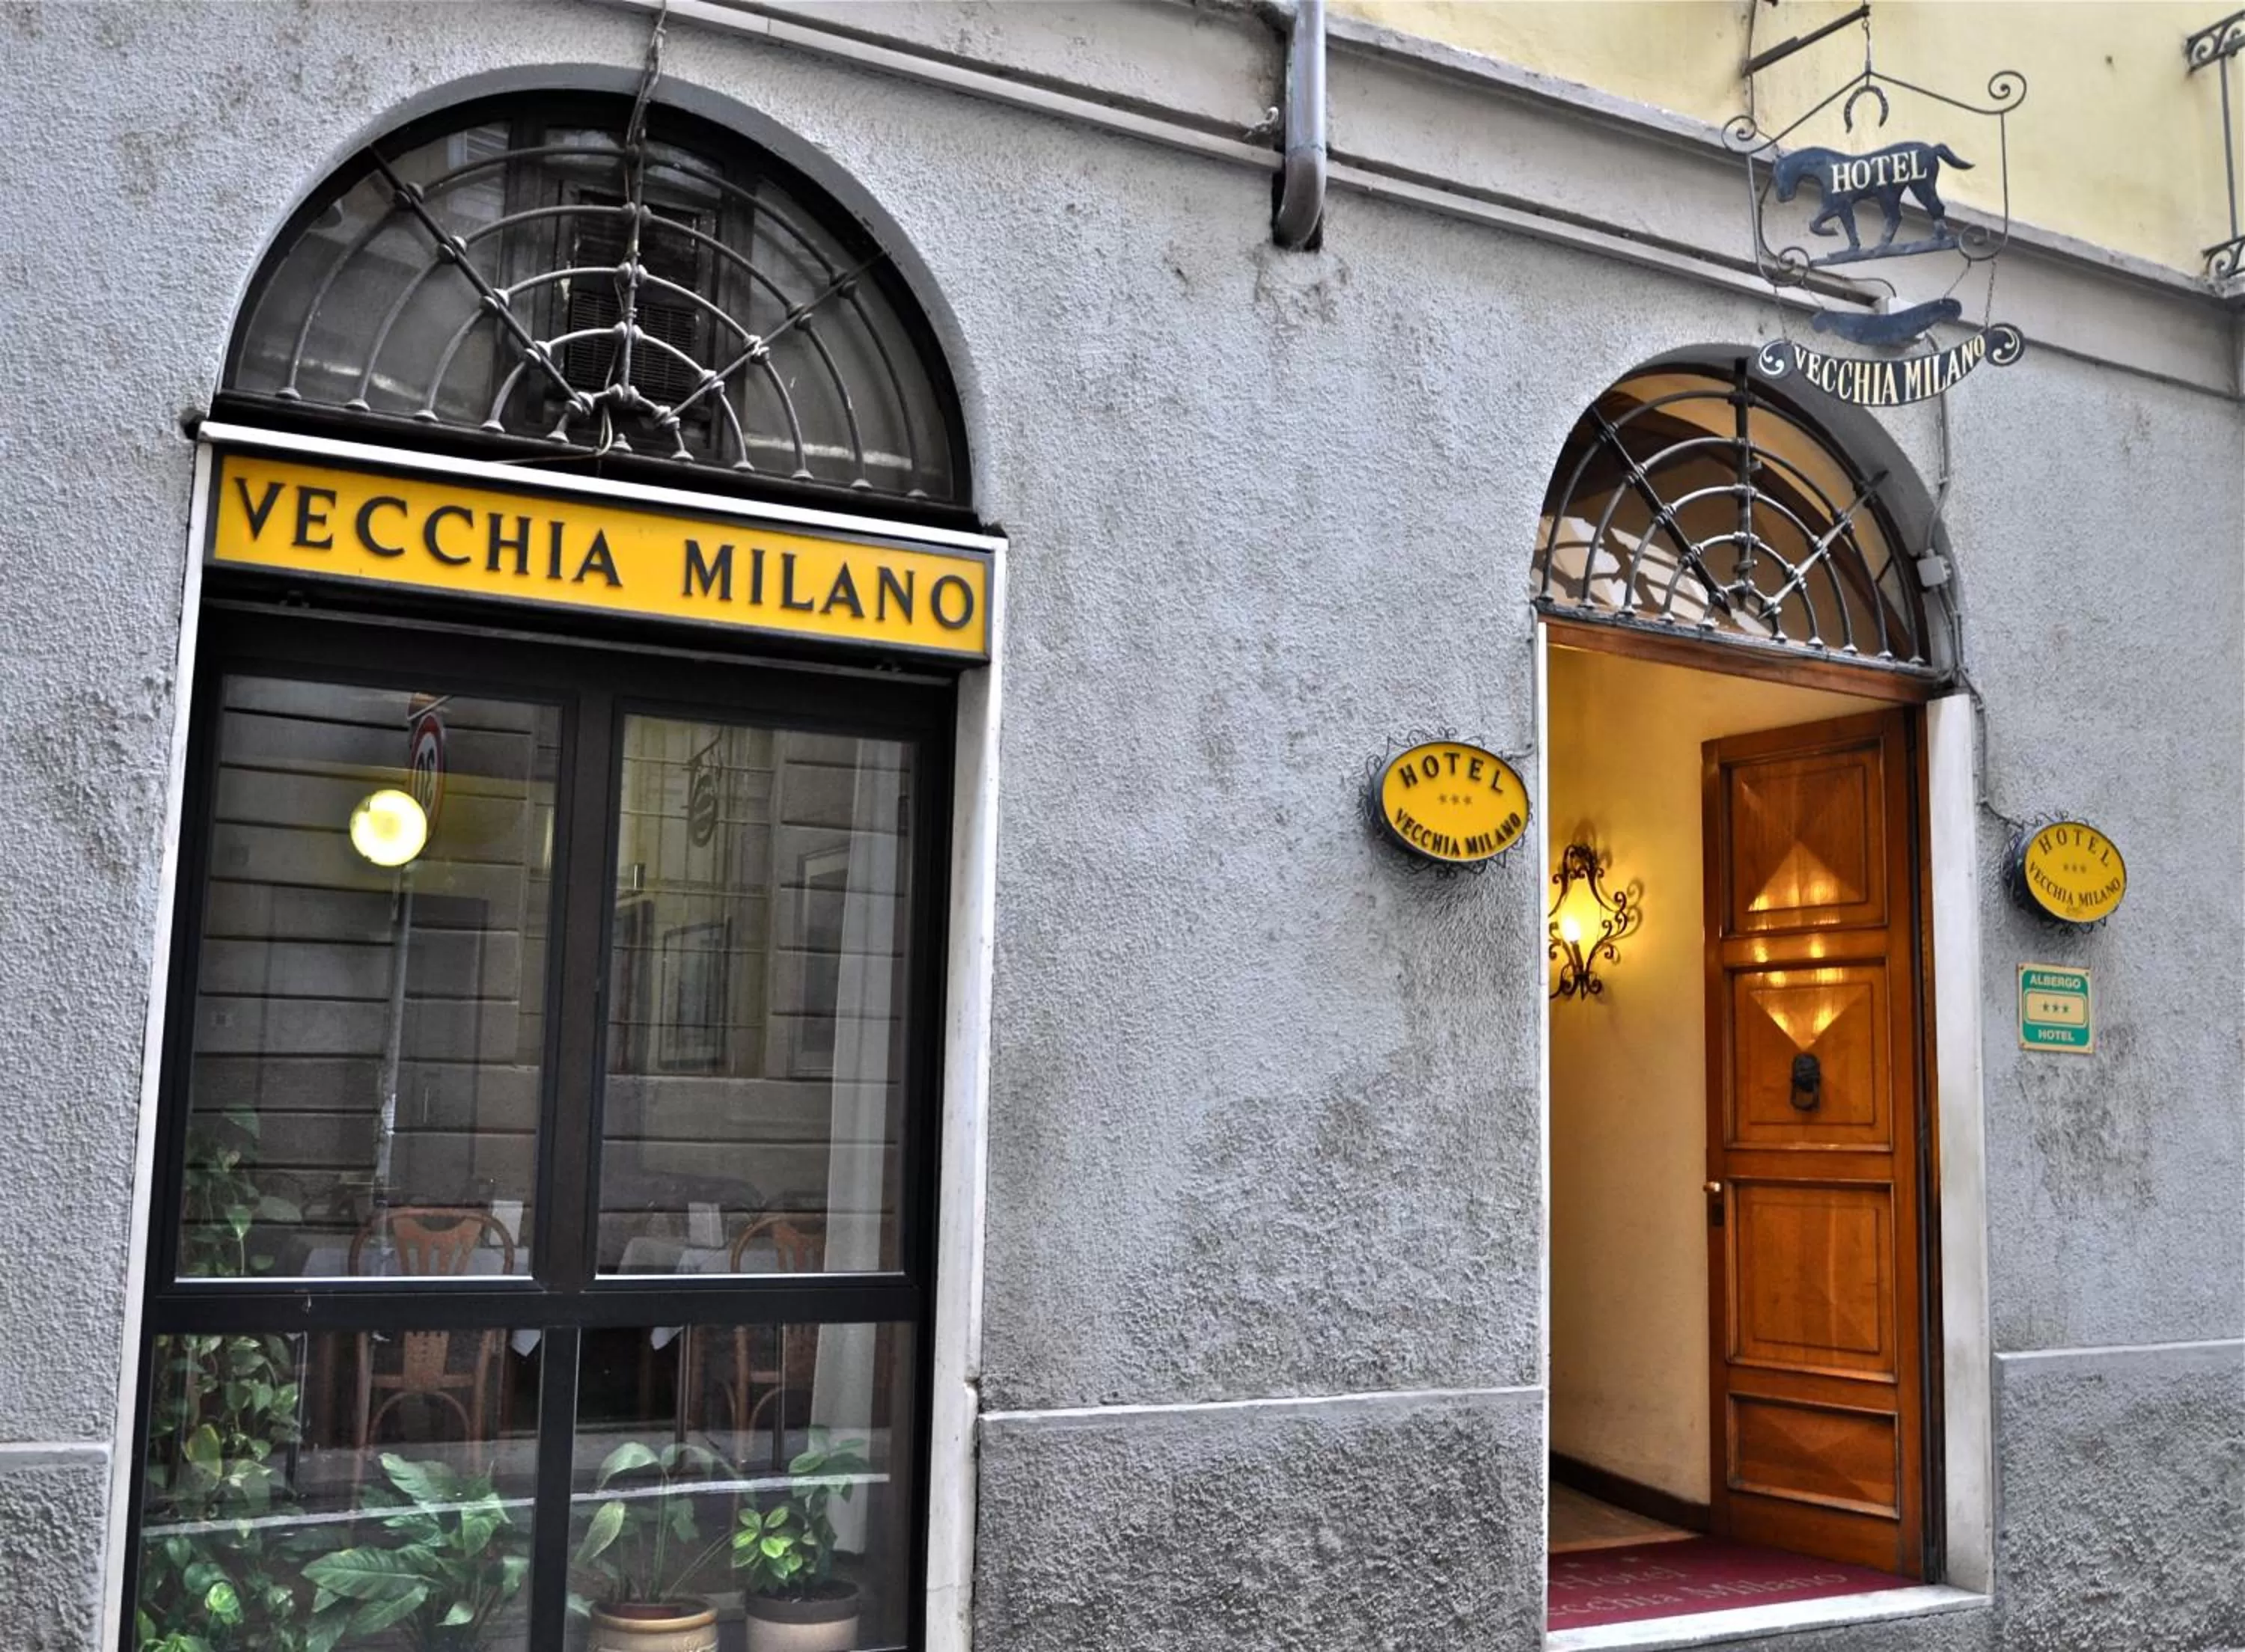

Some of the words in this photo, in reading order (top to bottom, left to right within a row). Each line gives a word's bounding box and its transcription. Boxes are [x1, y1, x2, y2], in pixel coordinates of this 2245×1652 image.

[1830, 150, 1928, 194] HOTEL
[1794, 346, 1899, 405] VECCHIA
[1905, 334, 1986, 402] MILANO
[233, 477, 623, 589] VECCHIA
[682, 539, 975, 631] MILANO
[1399, 752, 1504, 795] HOTEL
[1394, 807, 1461, 856] VECCHIA
[1464, 811, 1522, 856] MILANO
[2038, 827, 2110, 868] HOTEL
[2029, 861, 2074, 906] VECCHIA
[2077, 876, 2122, 907] MILANO
[2029, 973, 2081, 989] ALBERGO
[2038, 1029, 2075, 1042] HOTEL
[1548, 1592, 1683, 1616] ecchia
[1676, 1574, 1848, 1600] Milano
